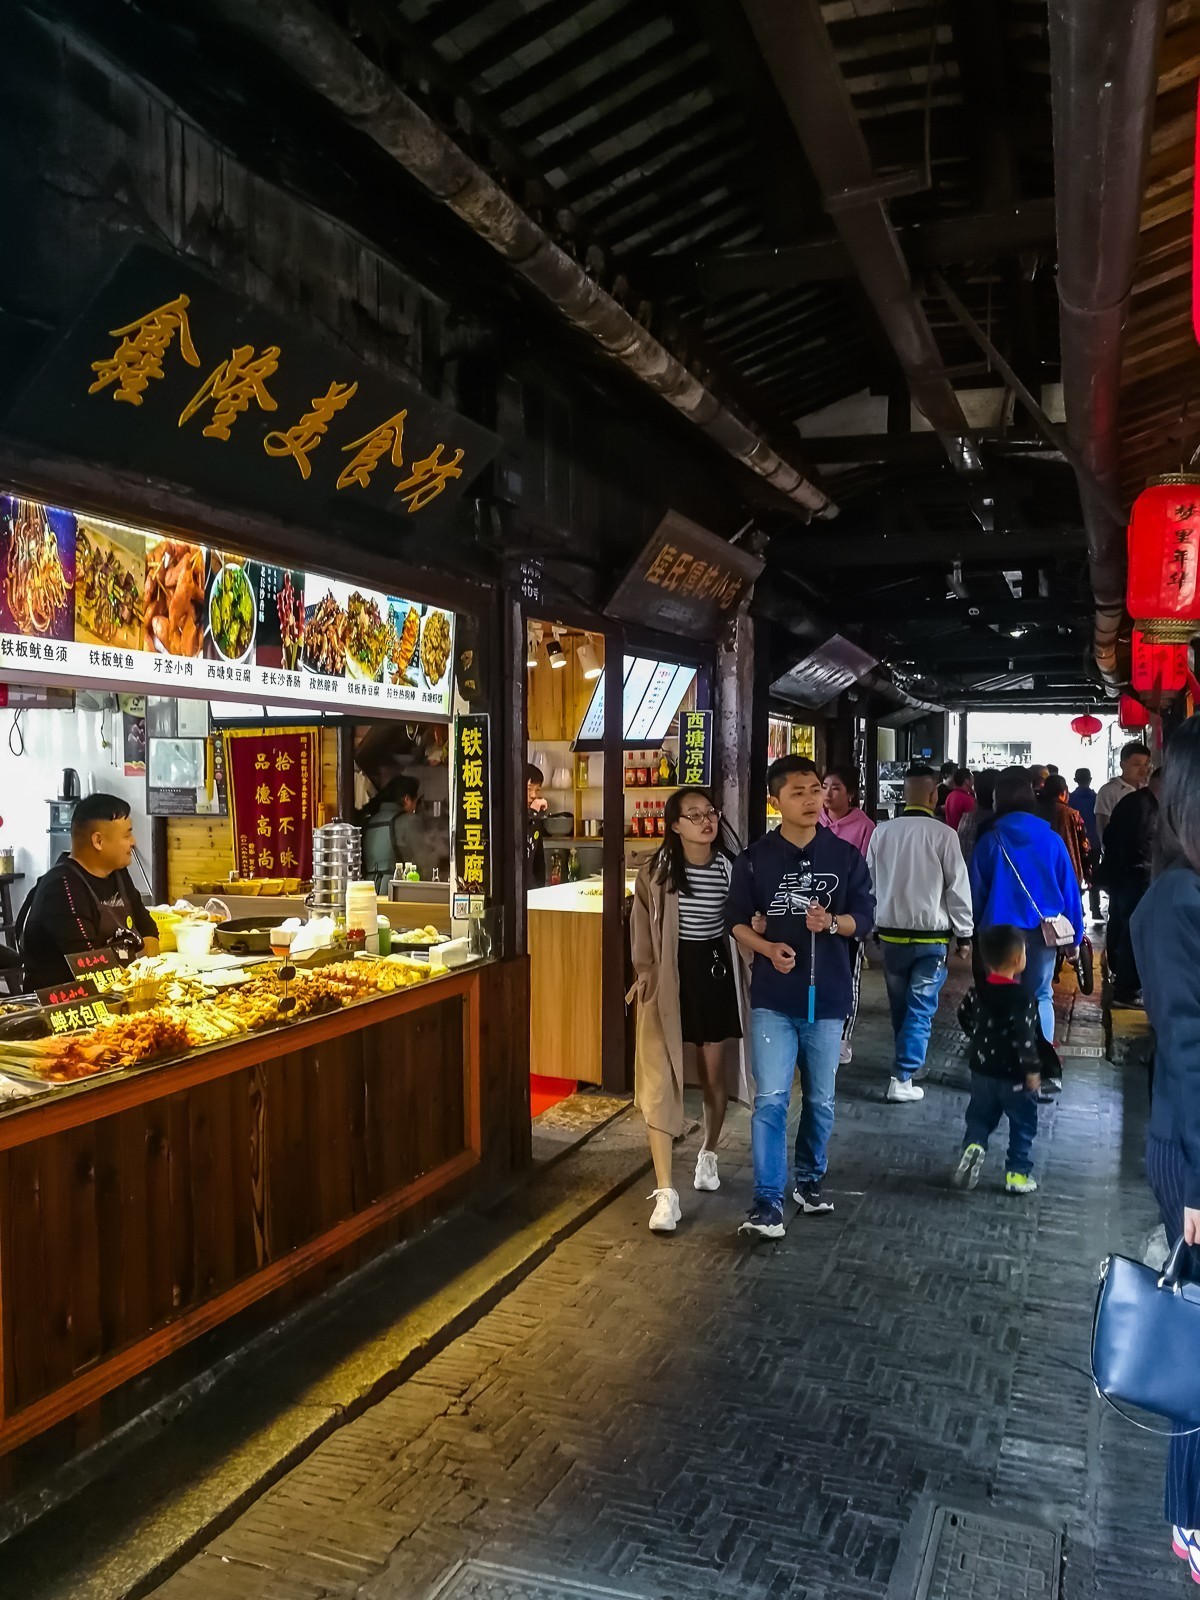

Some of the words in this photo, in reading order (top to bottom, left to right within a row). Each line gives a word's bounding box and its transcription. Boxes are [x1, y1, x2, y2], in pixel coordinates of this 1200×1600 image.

[1, 638, 68, 663] 铁板鱿鱼须
[89, 650, 135, 670] 铁板鱿鱼
[153, 658, 193, 676] 牙签小肉
[207, 664, 251, 683] 西塘臭豆腐
[261, 671, 301, 688] 老长沙香肠
[309, 677, 338, 692] 孜然脆骨
[347, 682, 380, 697] 铁板香豆腐
[684, 712, 705, 784] 西塘凉皮
[254, 752, 274, 870] 品德高尚
[274, 751, 299, 869] 拾金不昧
[461, 727, 484, 883] 铁板香豆腐
